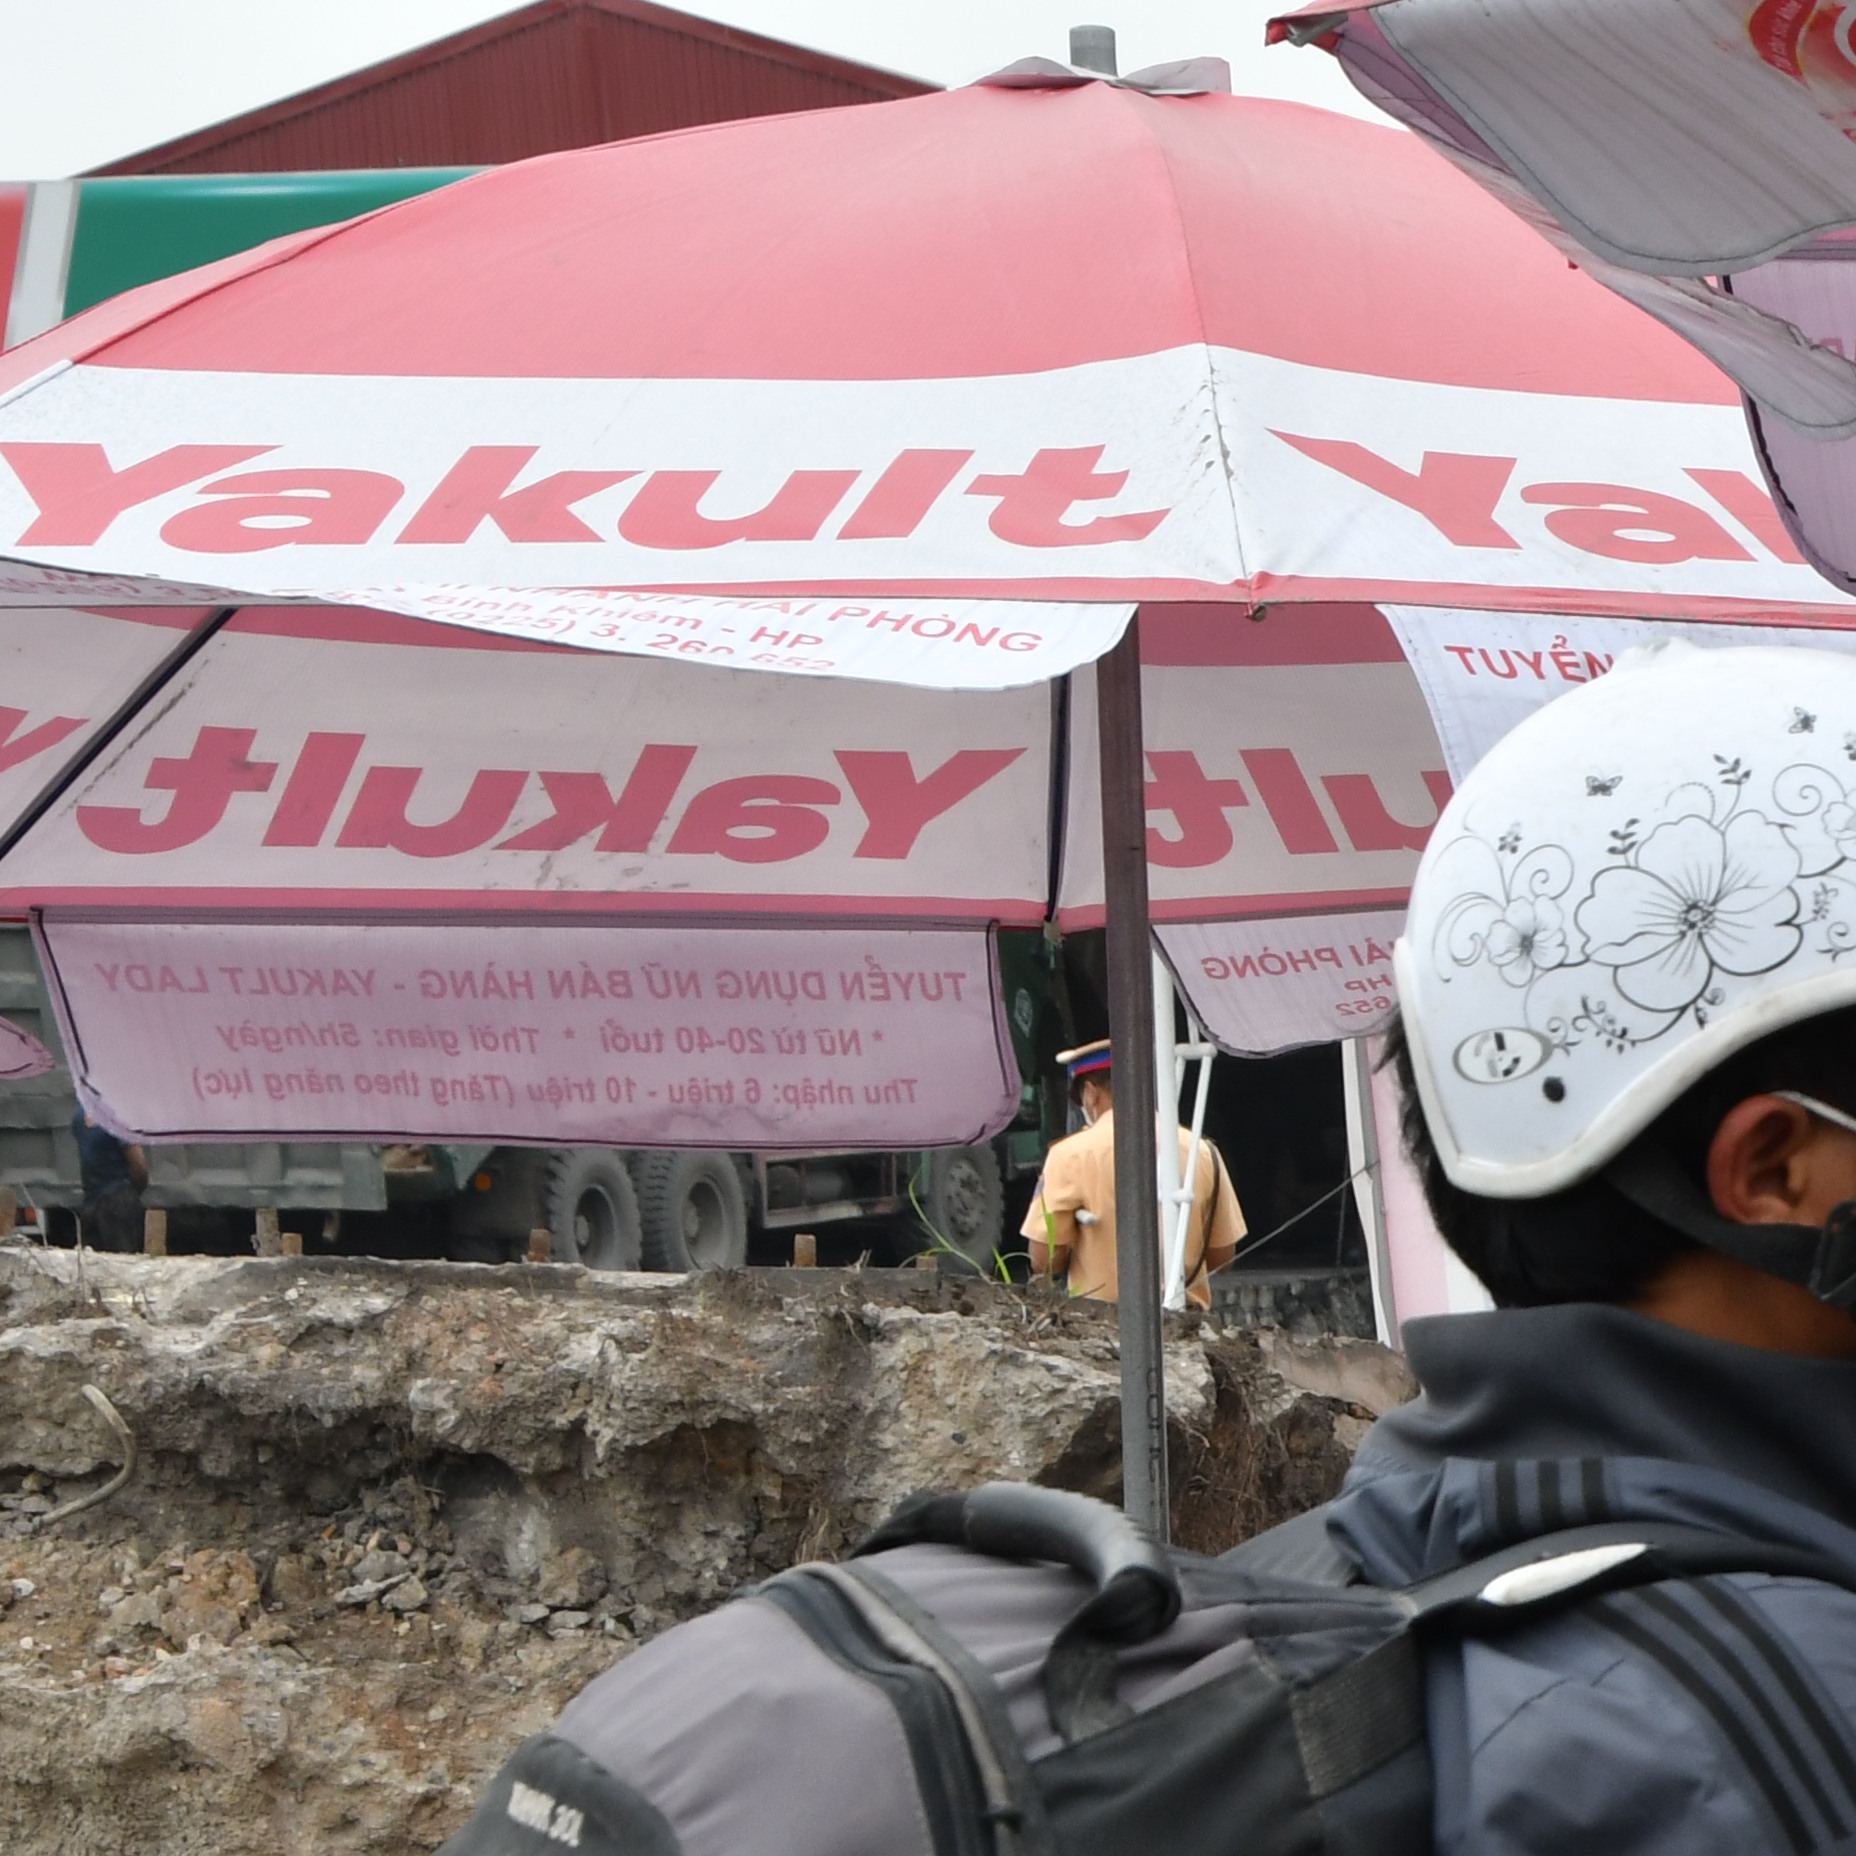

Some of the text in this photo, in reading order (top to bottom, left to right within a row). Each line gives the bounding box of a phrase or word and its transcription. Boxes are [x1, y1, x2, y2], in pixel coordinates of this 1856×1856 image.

[0, 440, 1172, 556] Yakult
[749, 626, 825, 651] HP
[828, 605, 1043, 653] PHÒNG
